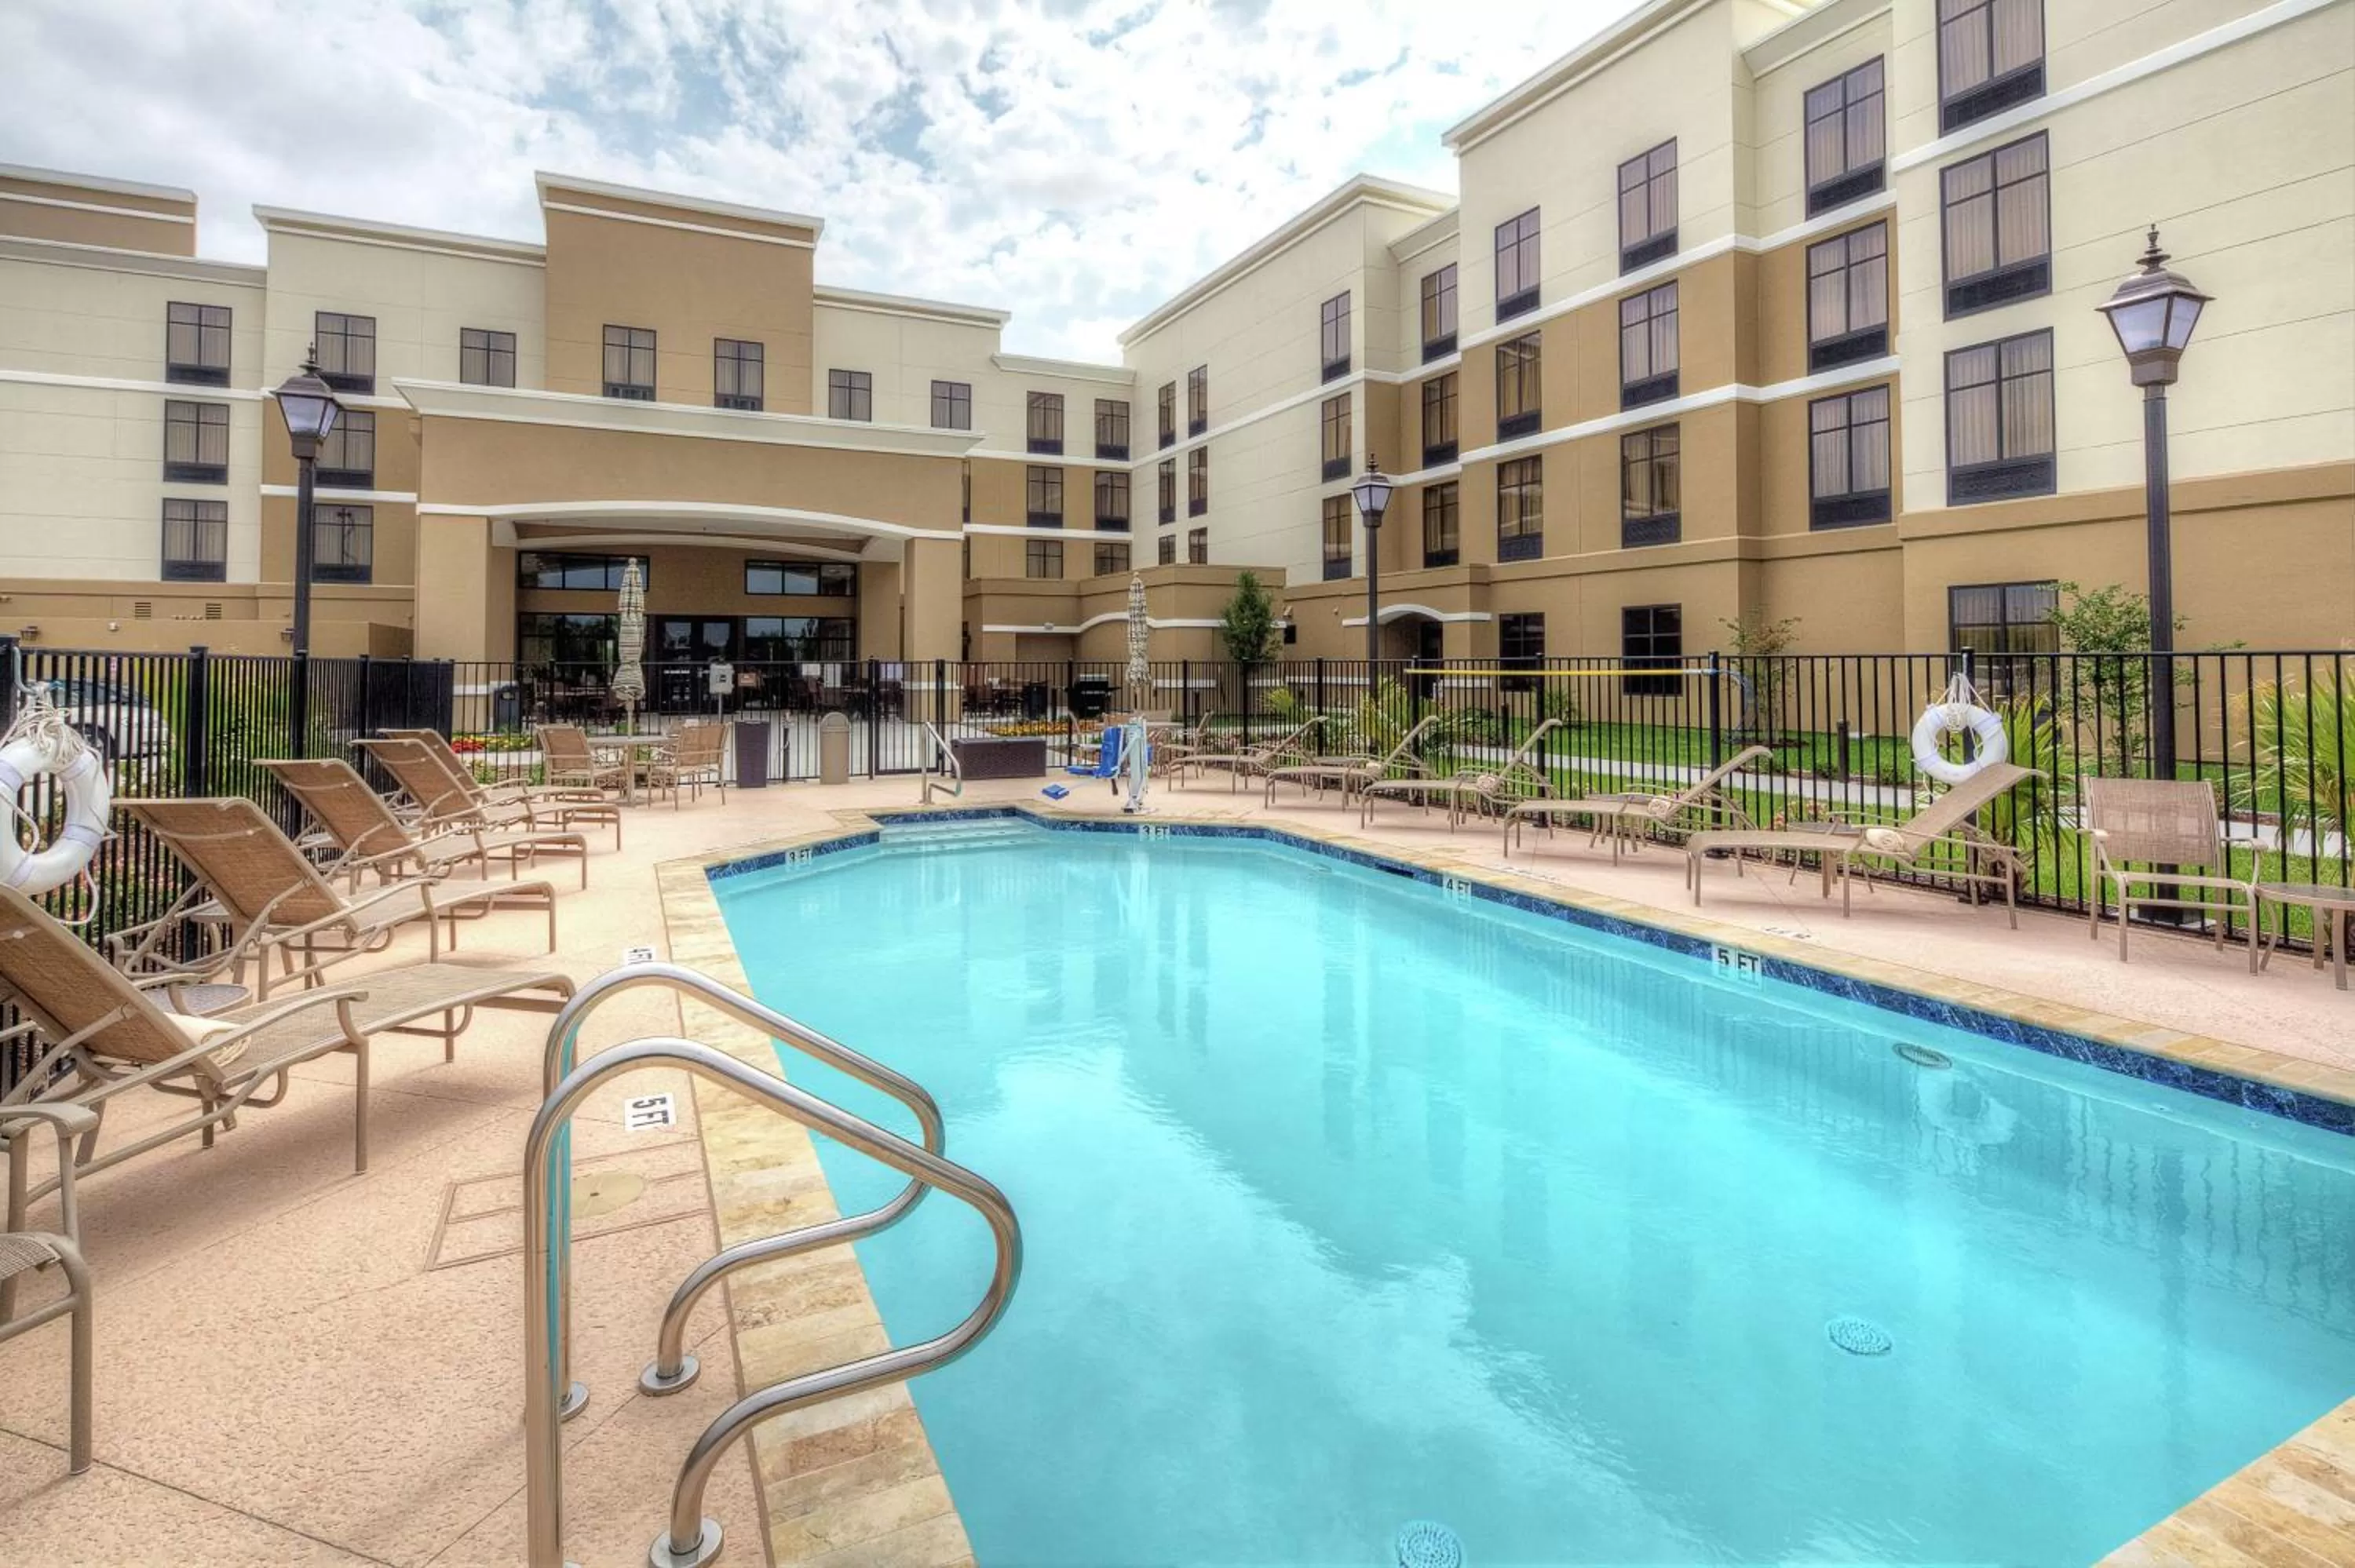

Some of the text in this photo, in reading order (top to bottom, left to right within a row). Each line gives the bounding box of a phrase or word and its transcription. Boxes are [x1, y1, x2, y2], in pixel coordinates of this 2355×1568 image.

[1458, 880, 1470, 894] FT
[1718, 947, 1758, 974] 5 FT
[632, 1096, 669, 1128] 5 FT
